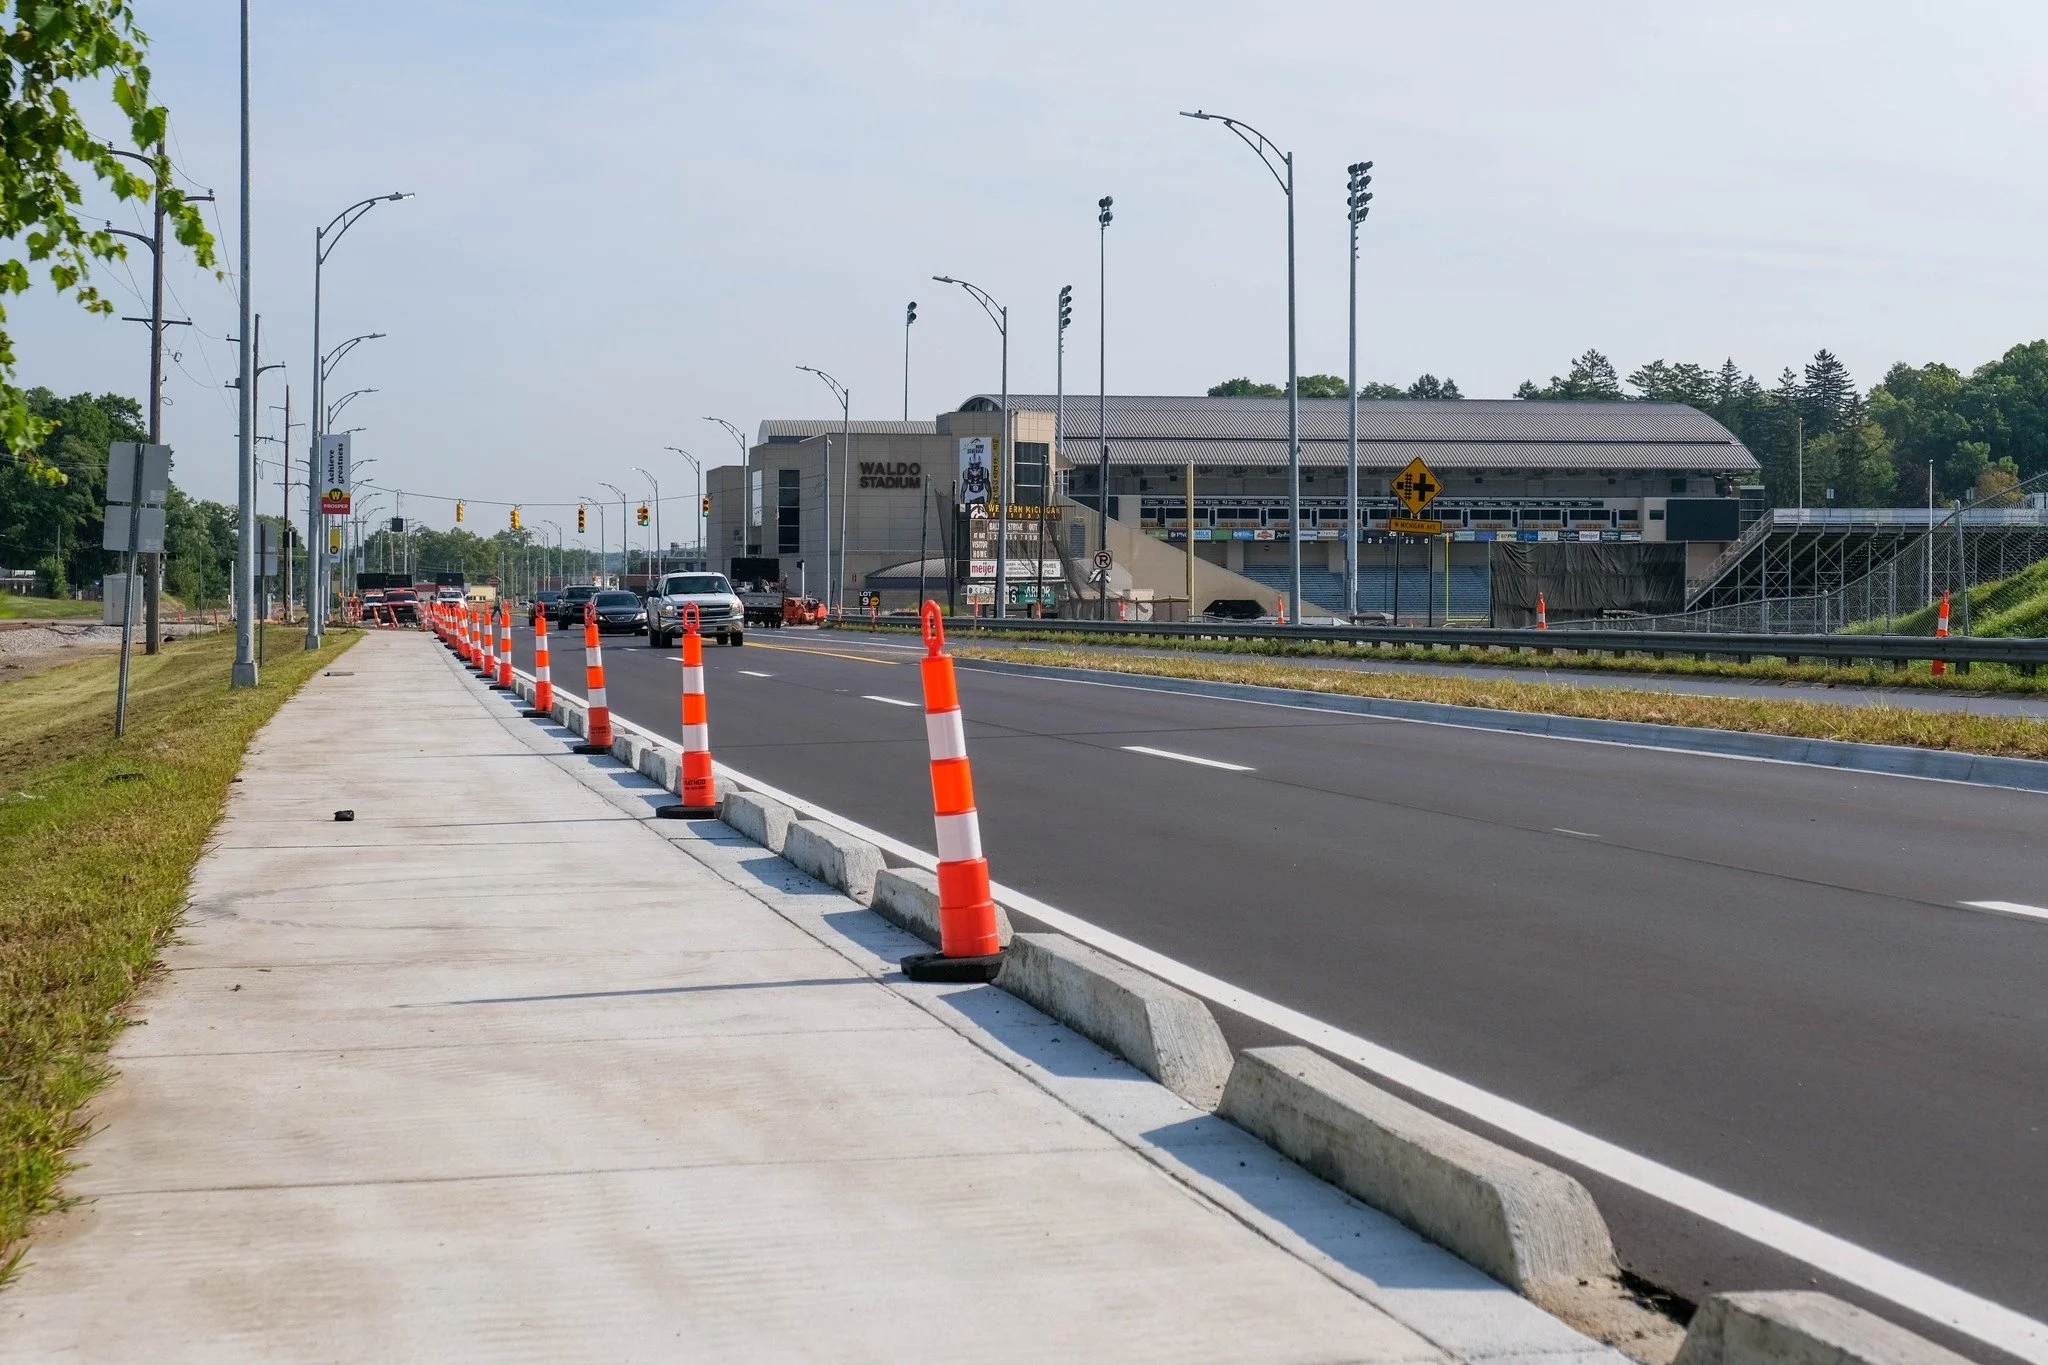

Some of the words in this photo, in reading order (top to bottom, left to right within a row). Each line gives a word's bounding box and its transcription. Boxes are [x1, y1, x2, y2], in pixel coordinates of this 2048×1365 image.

[337, 443, 345, 485] greatness
[860, 462, 922, 475] WALDO
[860, 476, 921, 489] STADIUM
[331, 491, 341, 500] W
[988, 504, 1023, 513] WEERN
[1025, 505, 1060, 514] MICGAN
[1007, 522, 1023, 531] STRIKE
[1028, 523, 1038, 531] OUT
[972, 540, 988, 549] VISITOR
[973, 550, 987, 558] HOME
[971, 562, 995, 576] meijer
[862, 596, 870, 606] 9
